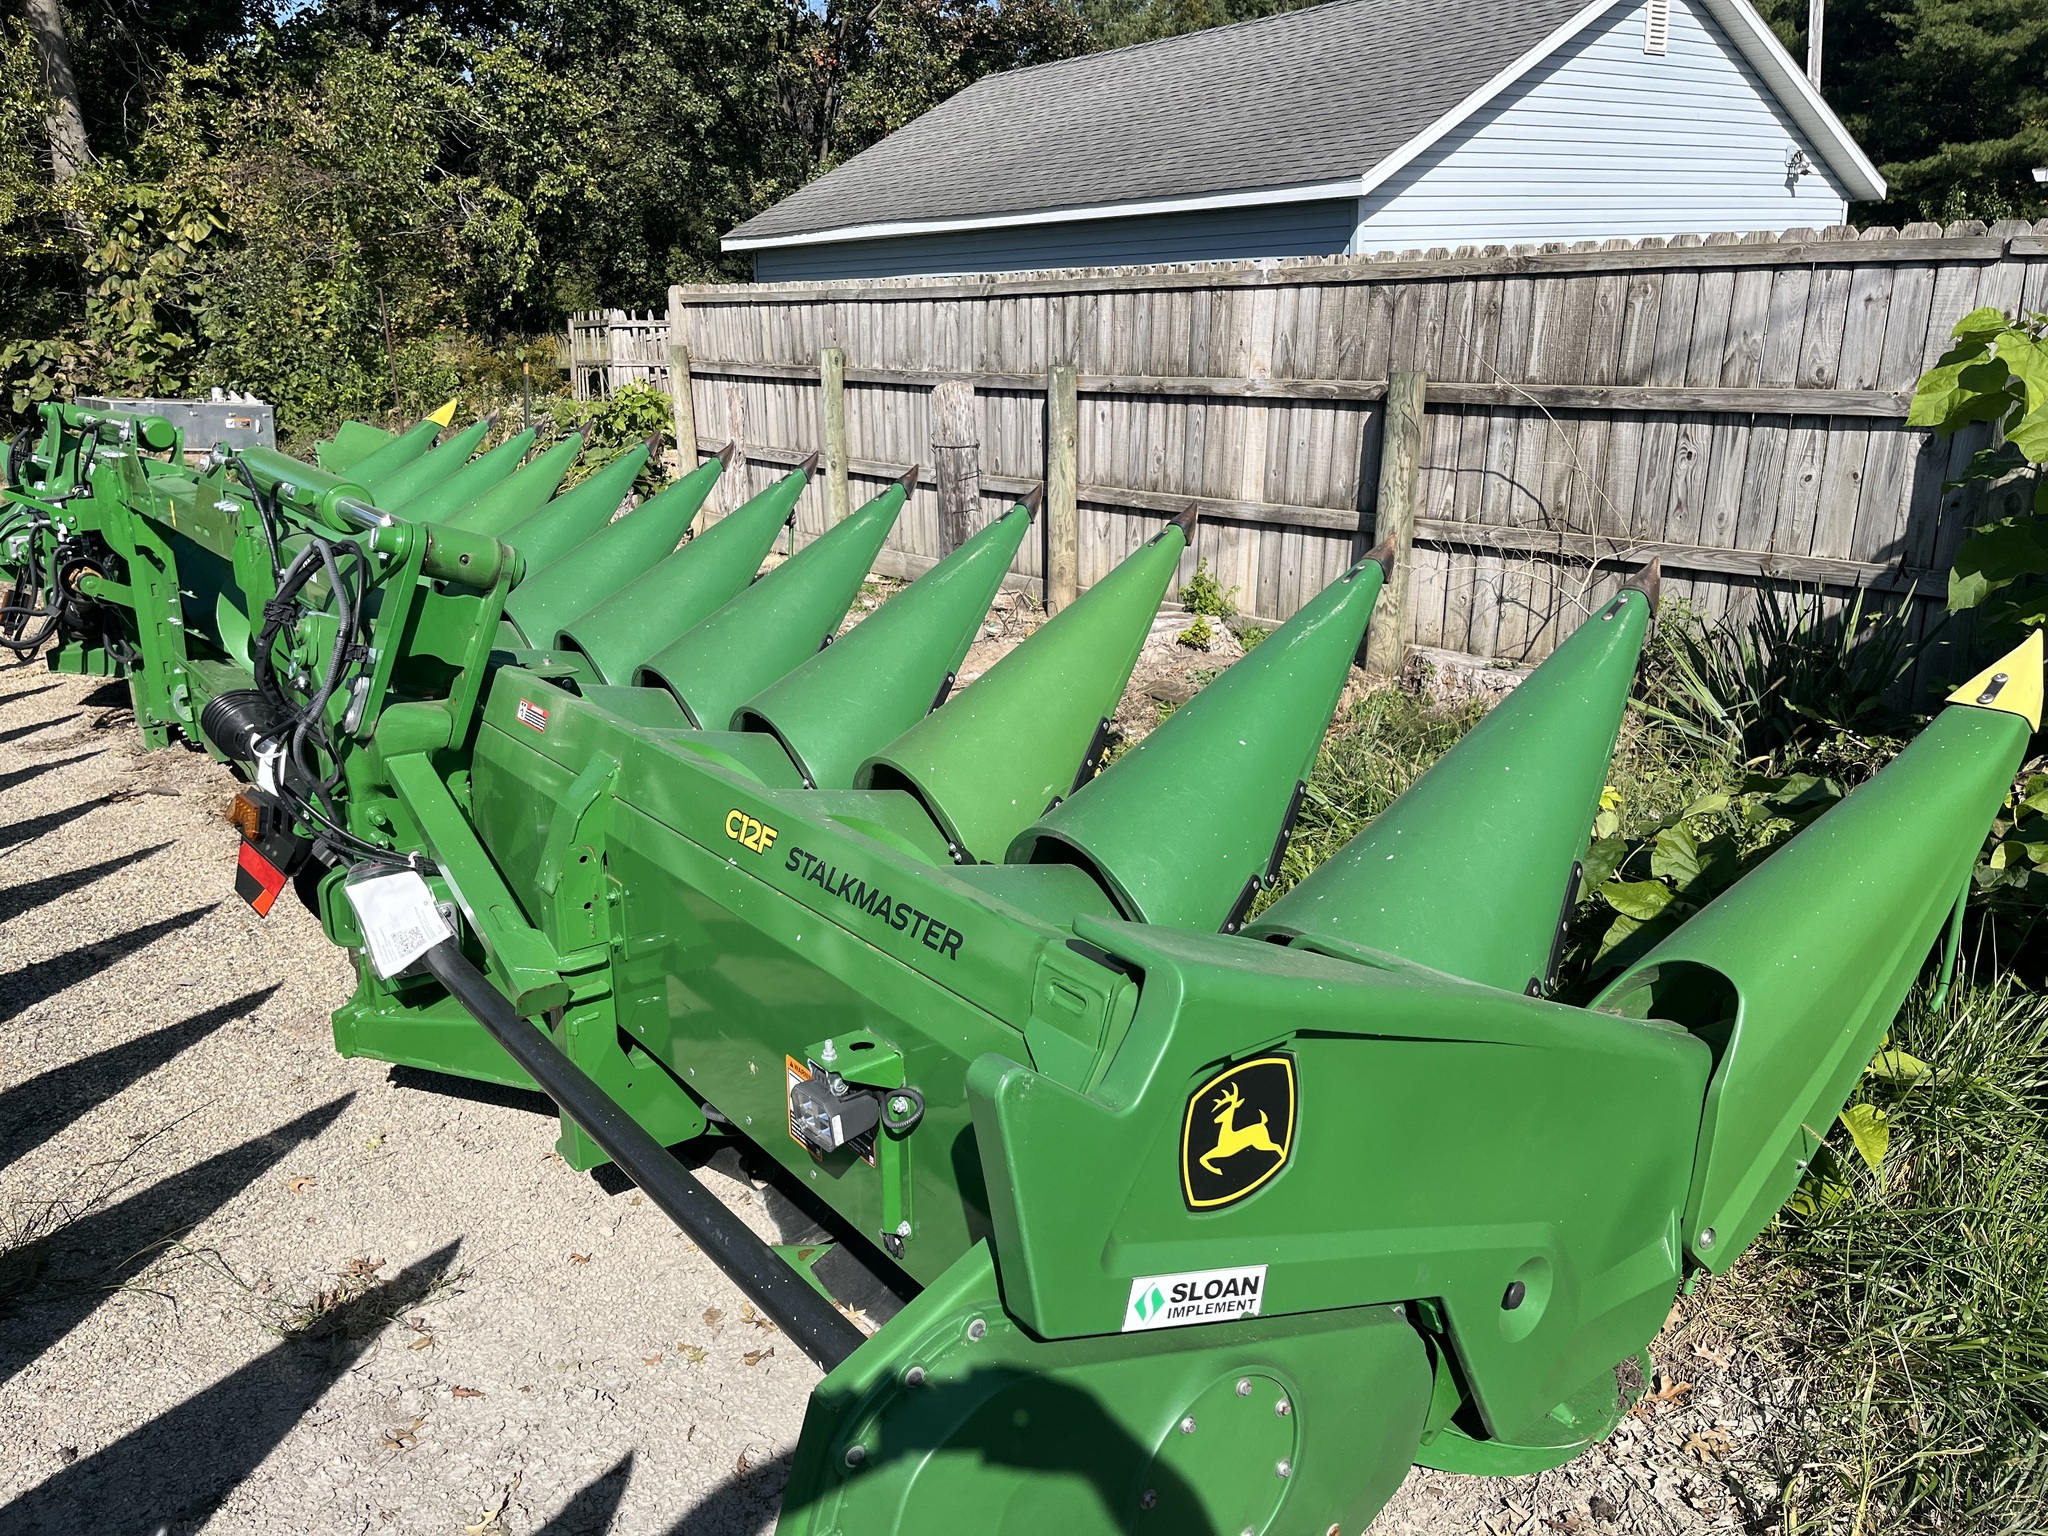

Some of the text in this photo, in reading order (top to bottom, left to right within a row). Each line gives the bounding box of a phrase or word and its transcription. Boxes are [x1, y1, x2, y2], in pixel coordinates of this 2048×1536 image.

[725, 808, 964, 961] C12F STALKMASTER
[1171, 1276, 1260, 1303] SLOAN
[1167, 1298, 1257, 1319] IMPLEMENT
